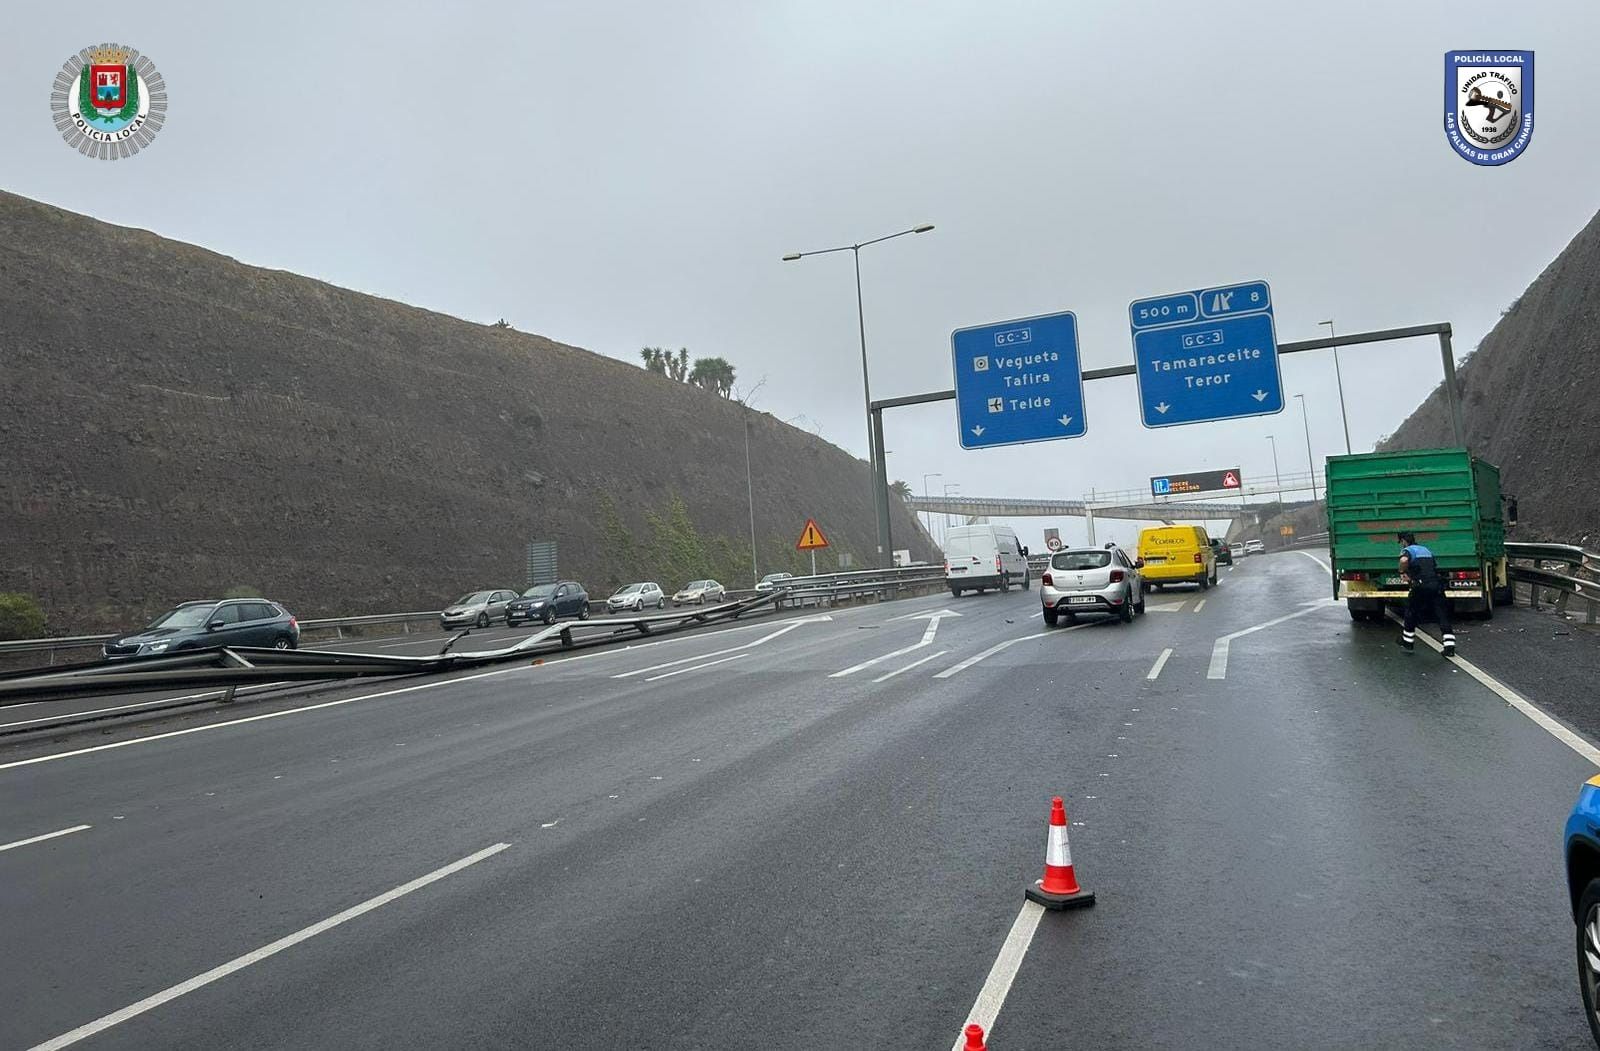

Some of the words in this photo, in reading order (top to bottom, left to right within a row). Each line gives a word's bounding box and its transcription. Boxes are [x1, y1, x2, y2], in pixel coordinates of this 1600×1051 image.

[1250, 291, 1260, 302] 8
[1140, 306, 1170, 319] 500
[1177, 305, 1188, 313] m
[997, 331, 1029, 344] GC-3
[1184, 332, 1221, 346] GC-3
[995, 351, 1059, 369] Vegueta
[1152, 348, 1260, 372] Tamaraceite
[1003, 373, 1050, 388] Tafira
[1185, 373, 1231, 388] Teror
[1010, 396, 1051, 411] Telde
